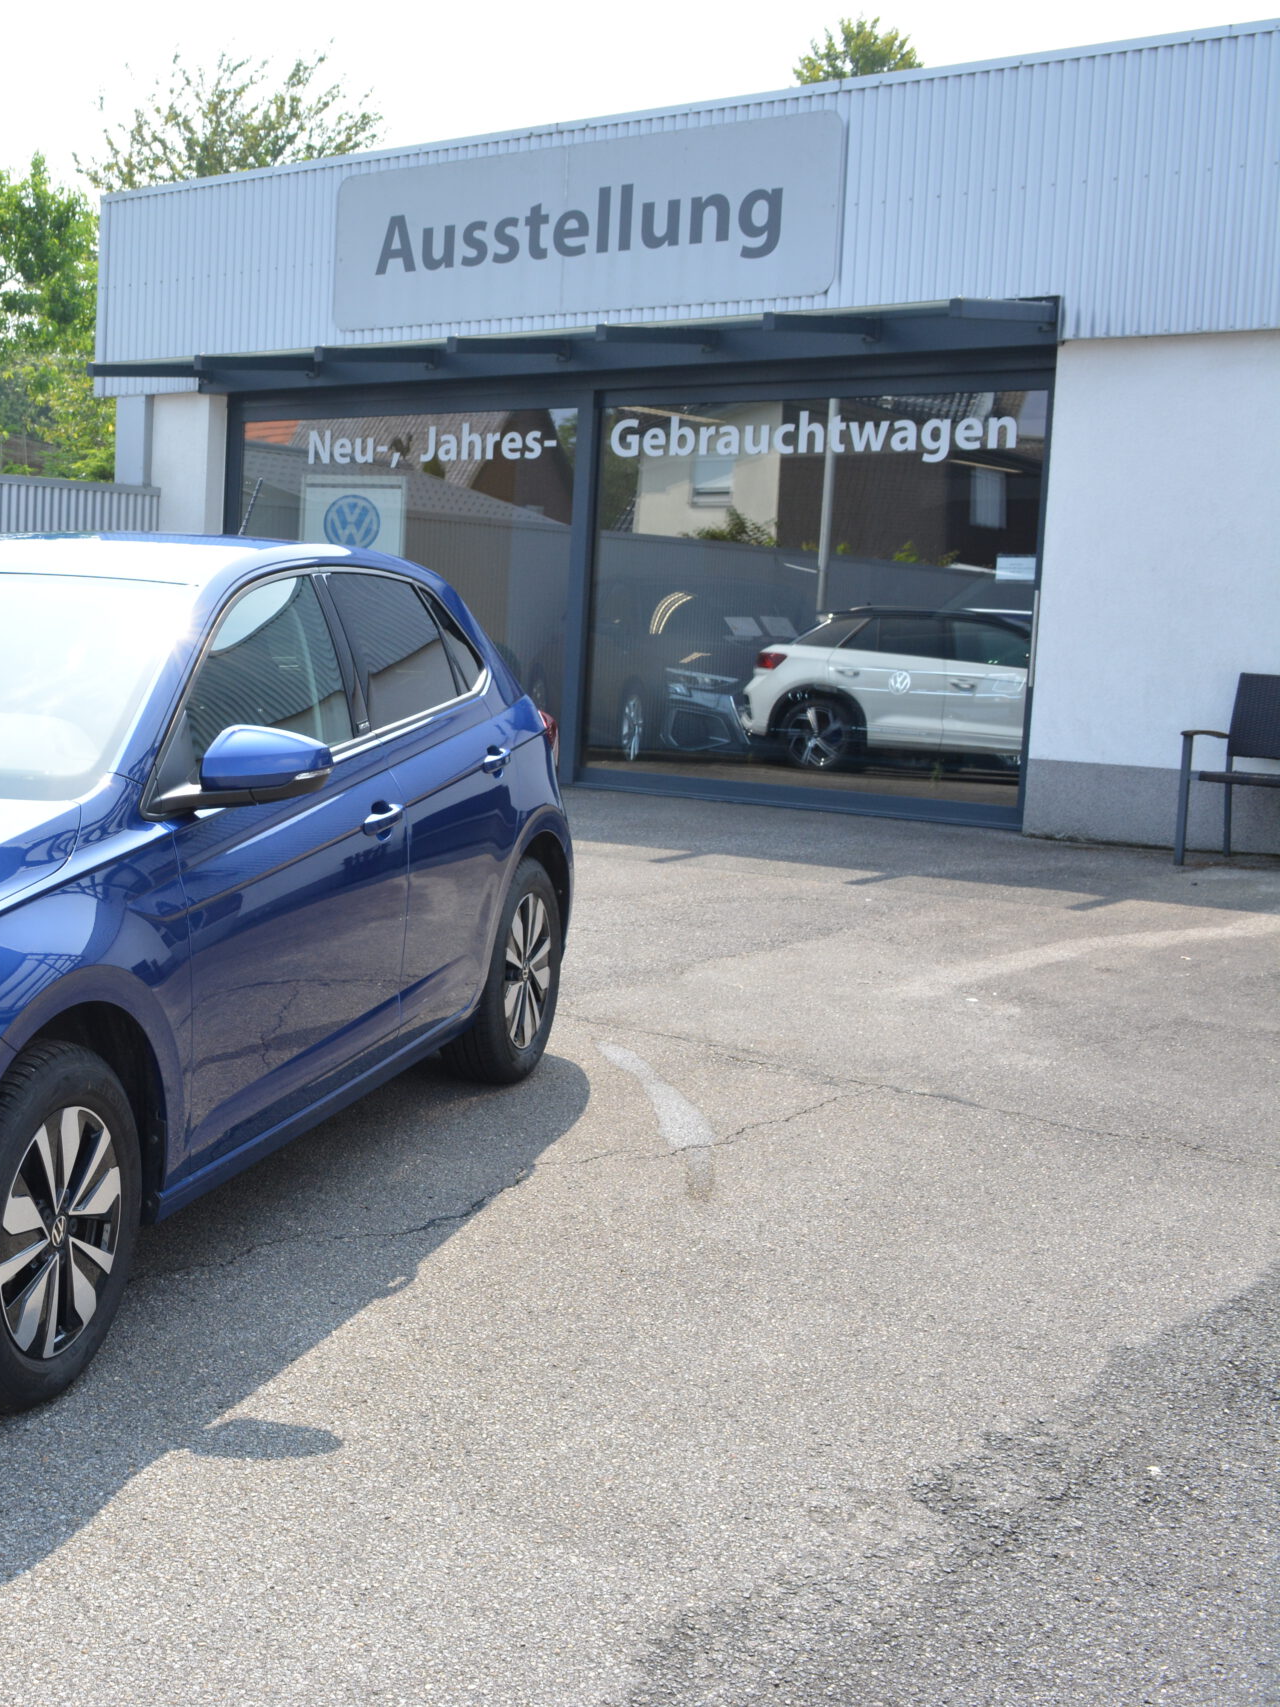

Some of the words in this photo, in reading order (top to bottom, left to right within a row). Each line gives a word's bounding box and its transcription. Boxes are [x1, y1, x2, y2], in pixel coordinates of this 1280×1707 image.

[375, 183, 783, 276] Ausstellung
[307, 429, 401, 468] Neu-,
[420, 422, 558, 463] Jahres-
[610, 410, 1018, 463] Gebrauchtwagen
[324, 495, 380, 548] VW
